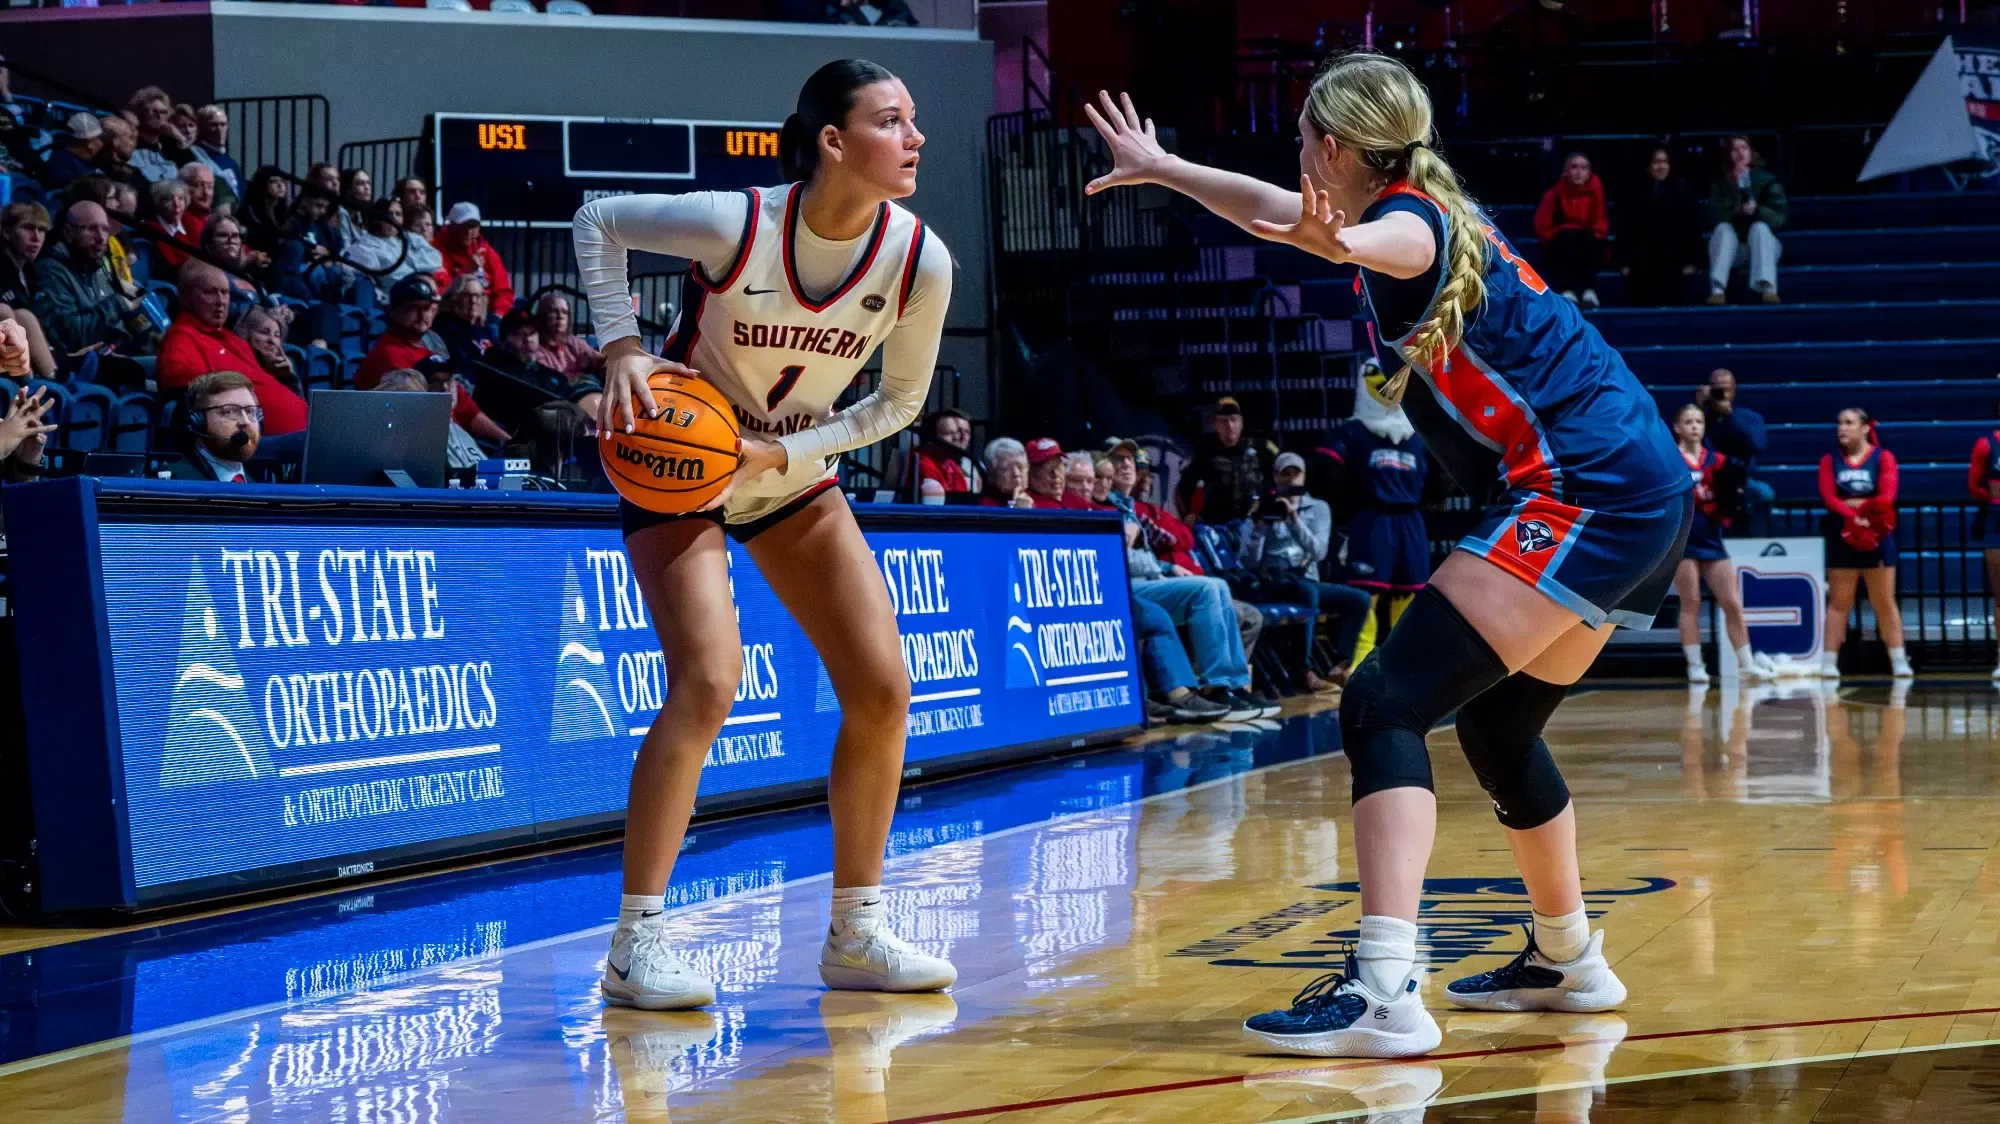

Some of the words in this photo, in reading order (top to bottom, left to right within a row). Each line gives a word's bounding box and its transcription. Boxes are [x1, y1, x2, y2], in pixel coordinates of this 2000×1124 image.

[478, 123, 527, 150] USI
[725, 131, 779, 156] UTM
[733, 320, 872, 359] SOUTHERN
[766, 364, 806, 413] 1
[731, 404, 813, 437] NDIANA
[615, 442, 705, 481] Wilson
[221, 547, 445, 650] TRI-STATE
[883, 547, 949, 616] STATE
[1018, 547, 1103, 609] TRI-STATE
[900, 628, 979, 683] OPAEDICS
[1037, 619, 1126, 670] ORTHOPAEDICS
[264, 661, 497, 749] ORTHOPAEDICS
[283, 795, 298, 827] &
[299, 777, 408, 825] ORTHOPAEDIC
[408, 771, 466, 809] URGENT
[467, 766, 505, 802] CARE
[338, 862, 374, 877] DAKTRONICS
